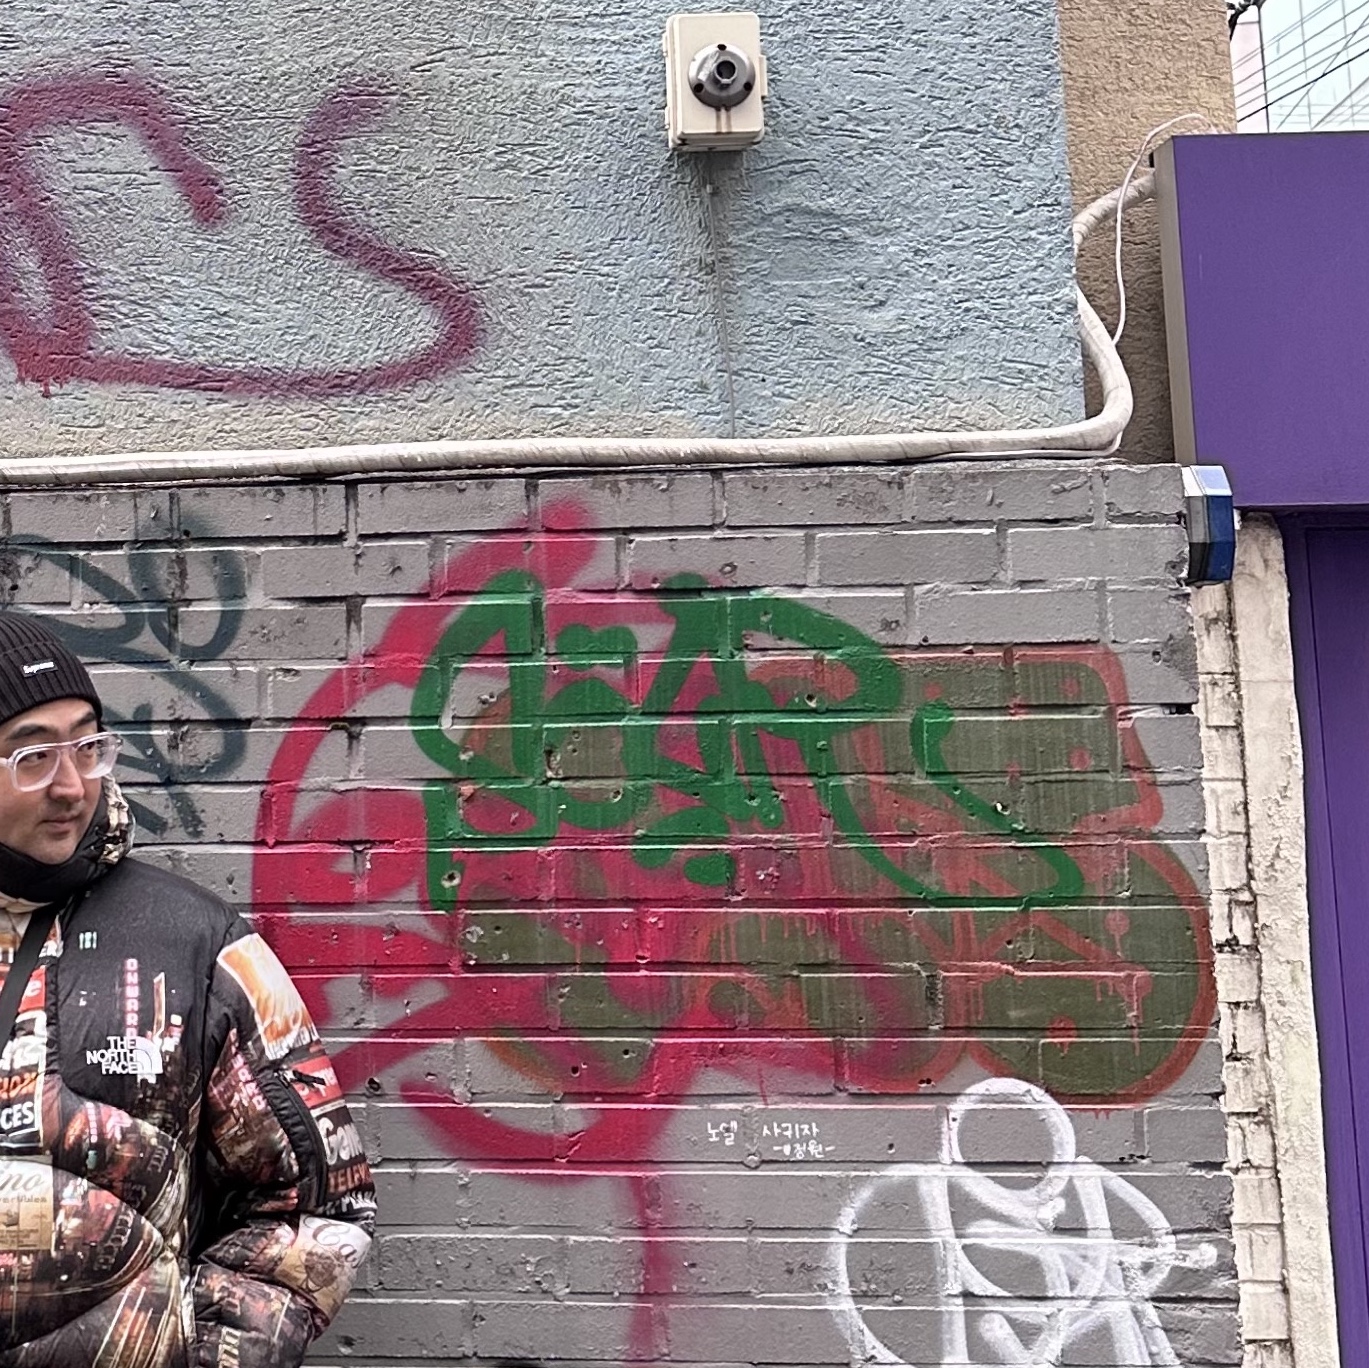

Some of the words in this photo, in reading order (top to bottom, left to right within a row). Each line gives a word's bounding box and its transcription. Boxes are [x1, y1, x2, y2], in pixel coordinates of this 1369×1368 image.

[107, 1036, 137, 1050] THE
[86, 1048, 138, 1065] NORTH
[101, 1061, 138, 1075] FACE
